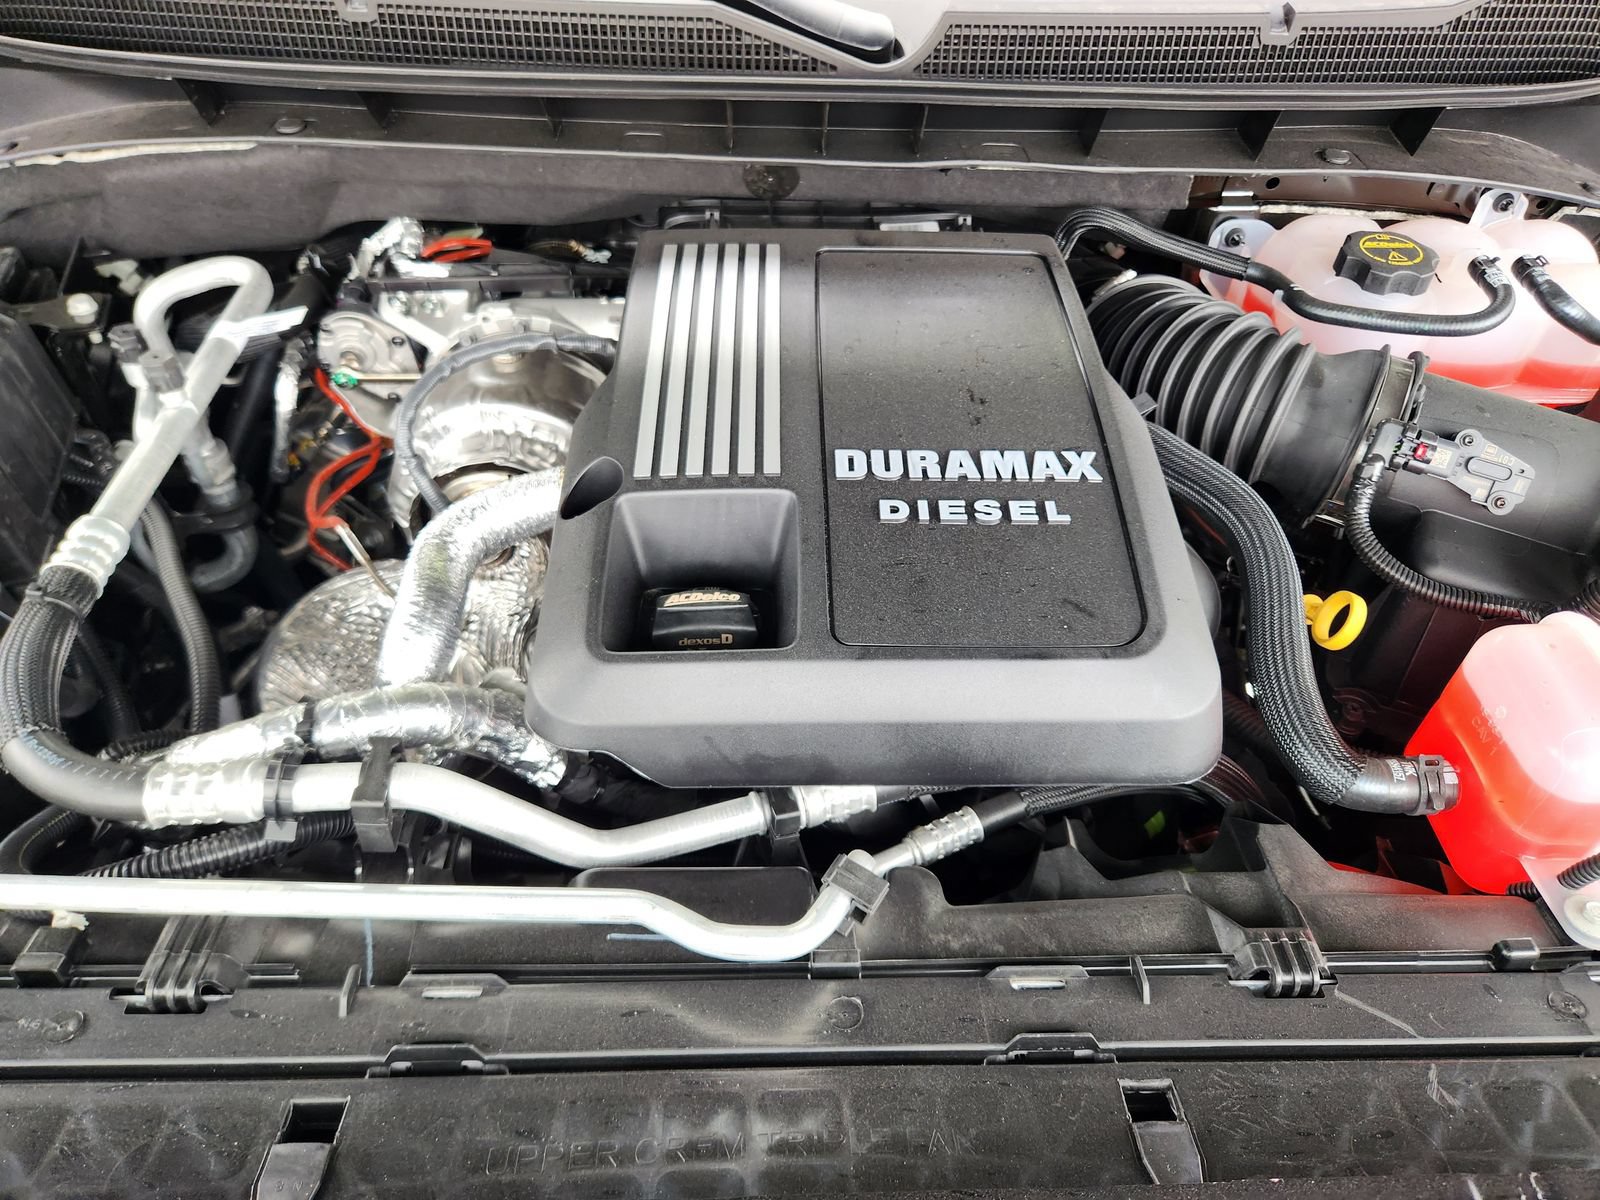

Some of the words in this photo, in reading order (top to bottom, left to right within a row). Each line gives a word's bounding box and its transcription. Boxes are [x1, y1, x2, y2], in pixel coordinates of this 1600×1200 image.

[834, 448, 1103, 483] DURAMAX
[879, 498, 1072, 525] DIESEL
[664, 591, 742, 607] ACDelco
[486, 1140, 618, 1176] UPPER
